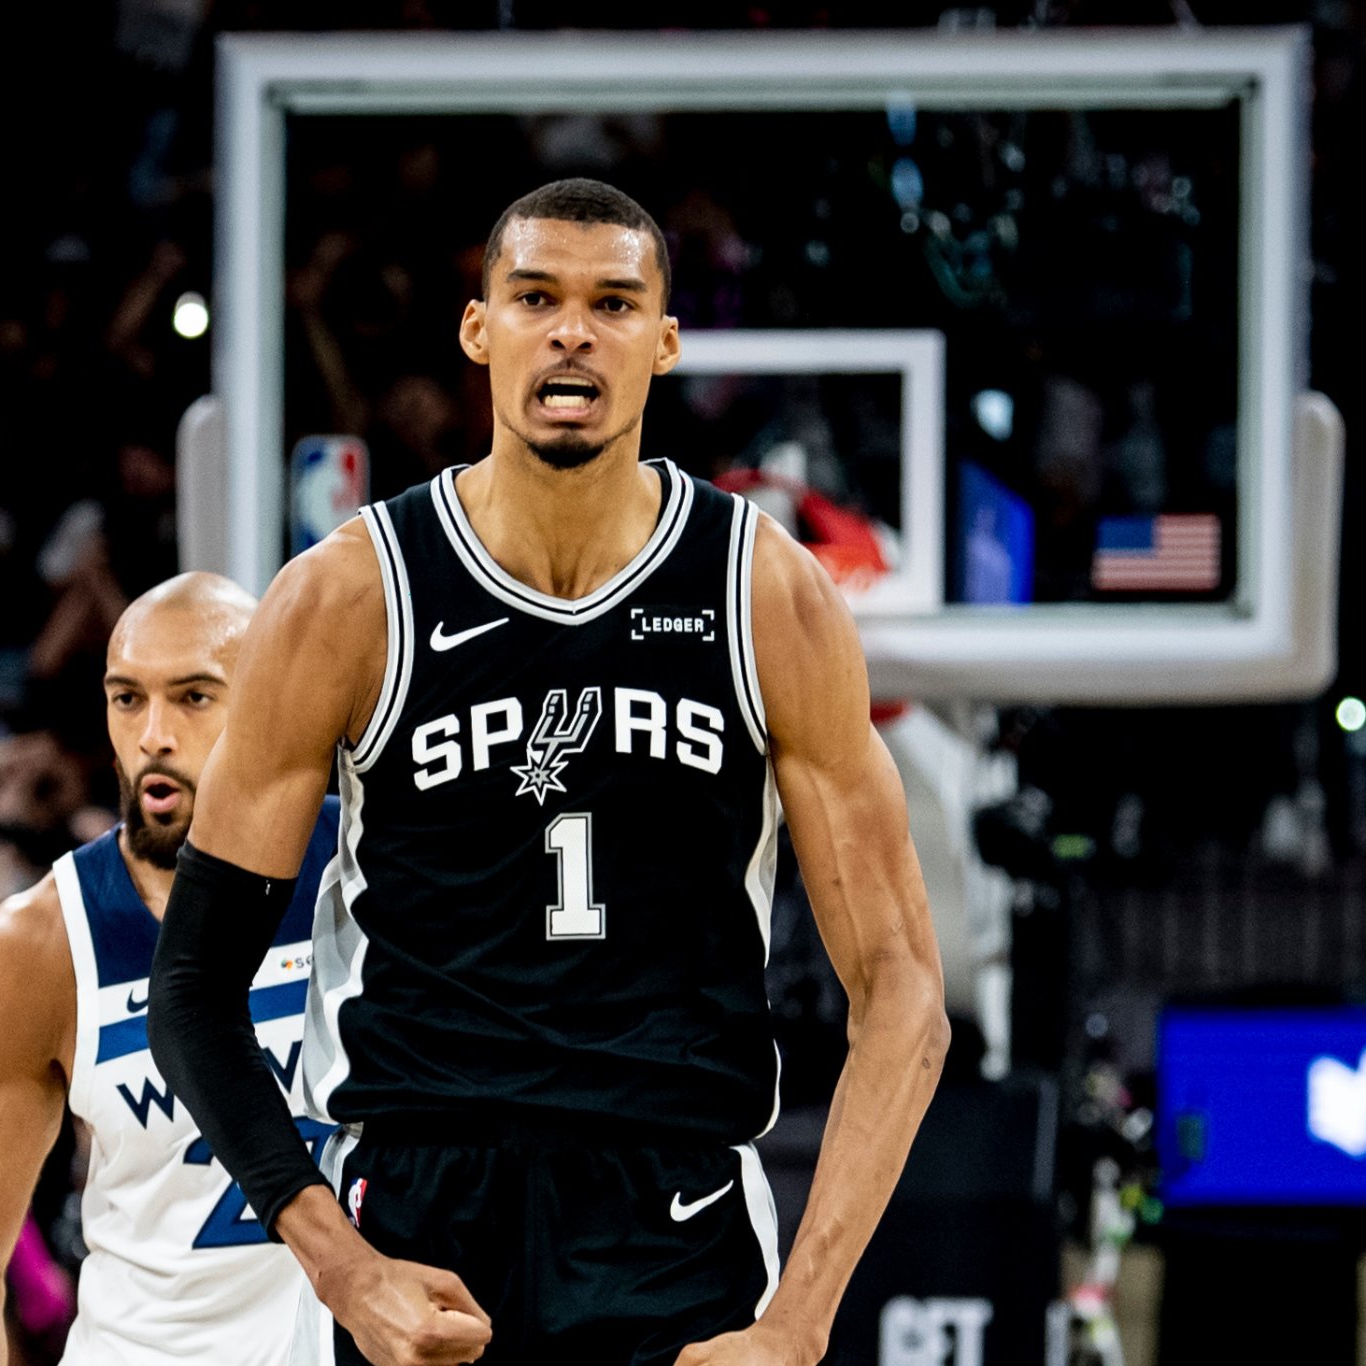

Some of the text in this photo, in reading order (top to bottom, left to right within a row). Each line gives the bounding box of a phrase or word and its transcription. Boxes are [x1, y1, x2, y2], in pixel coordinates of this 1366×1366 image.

[641, 616, 705, 633] LEDGER
[411, 687, 725, 806] SPURS
[545, 812, 606, 940] 1
